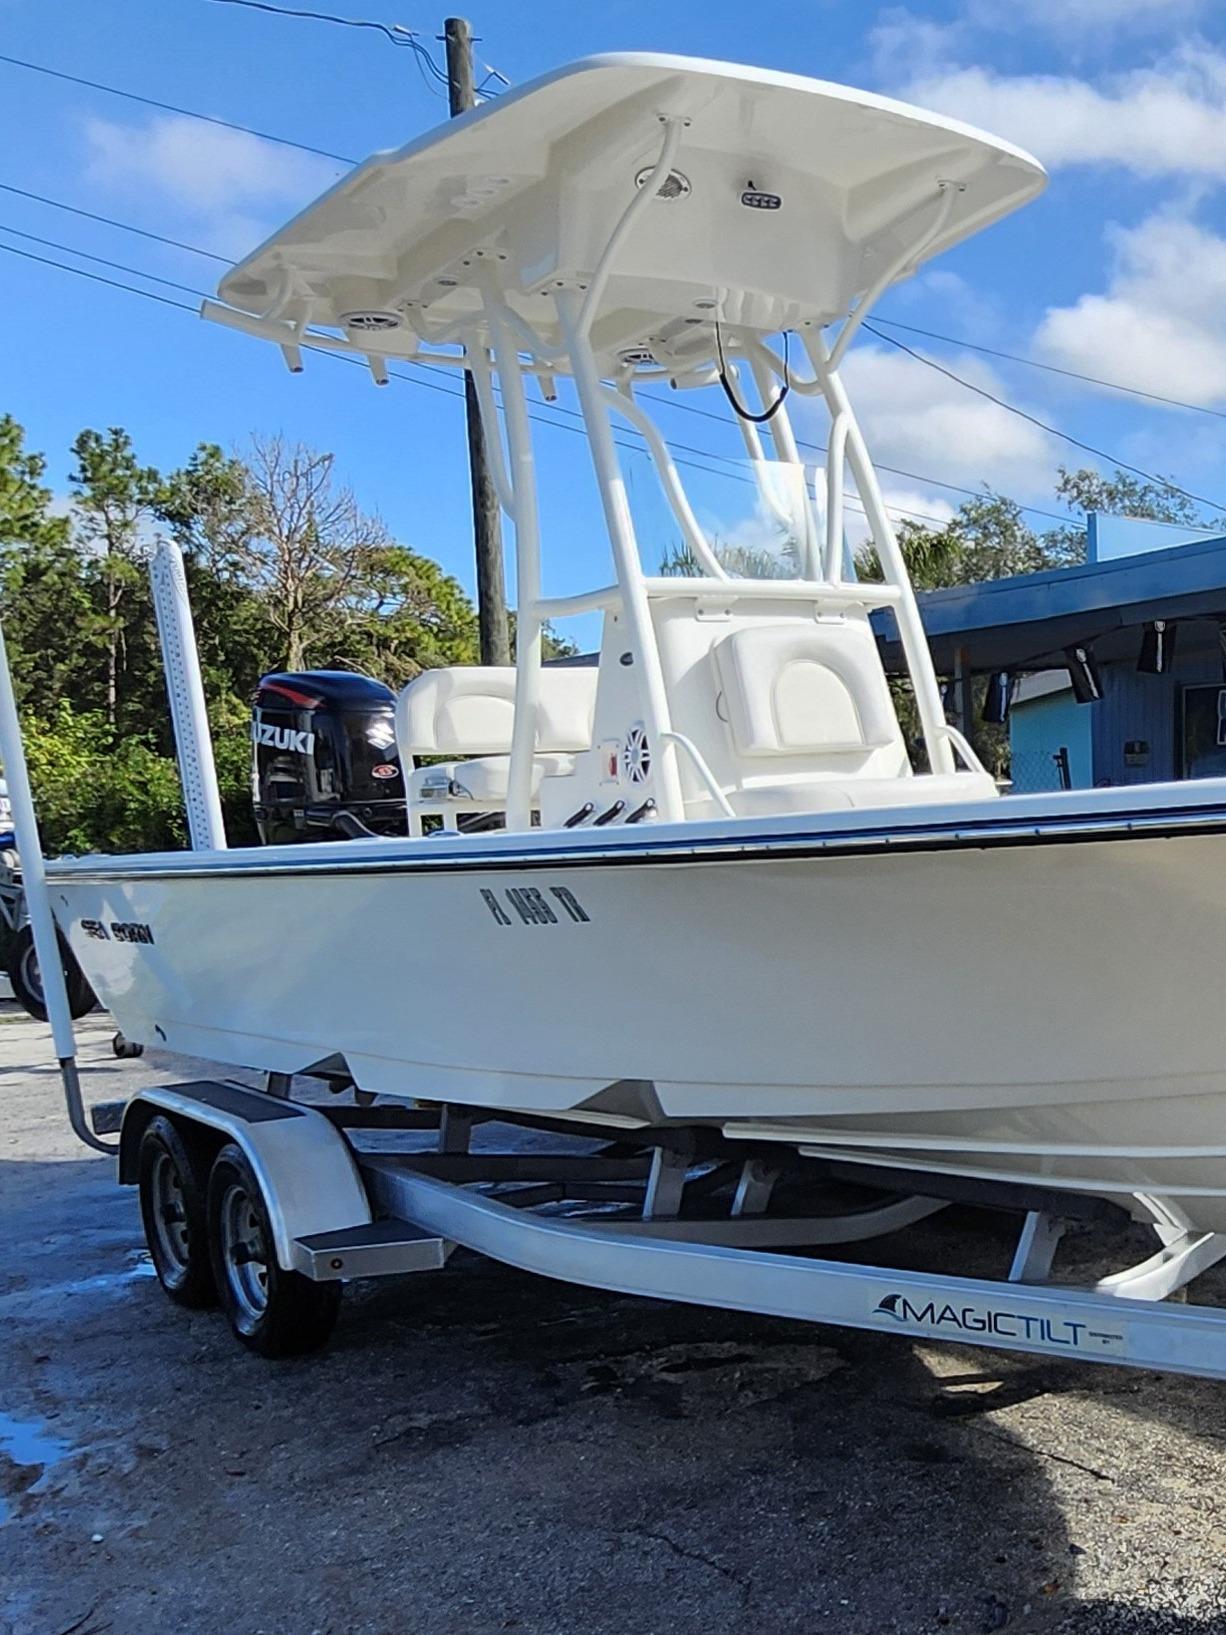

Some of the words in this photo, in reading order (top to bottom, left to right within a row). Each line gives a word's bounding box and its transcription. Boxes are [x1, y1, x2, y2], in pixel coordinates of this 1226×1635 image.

[252, 721, 315, 756] UZUKI
[480, 887, 512, 926] FL
[902, 1297, 1087, 1346] MAGICTILT
